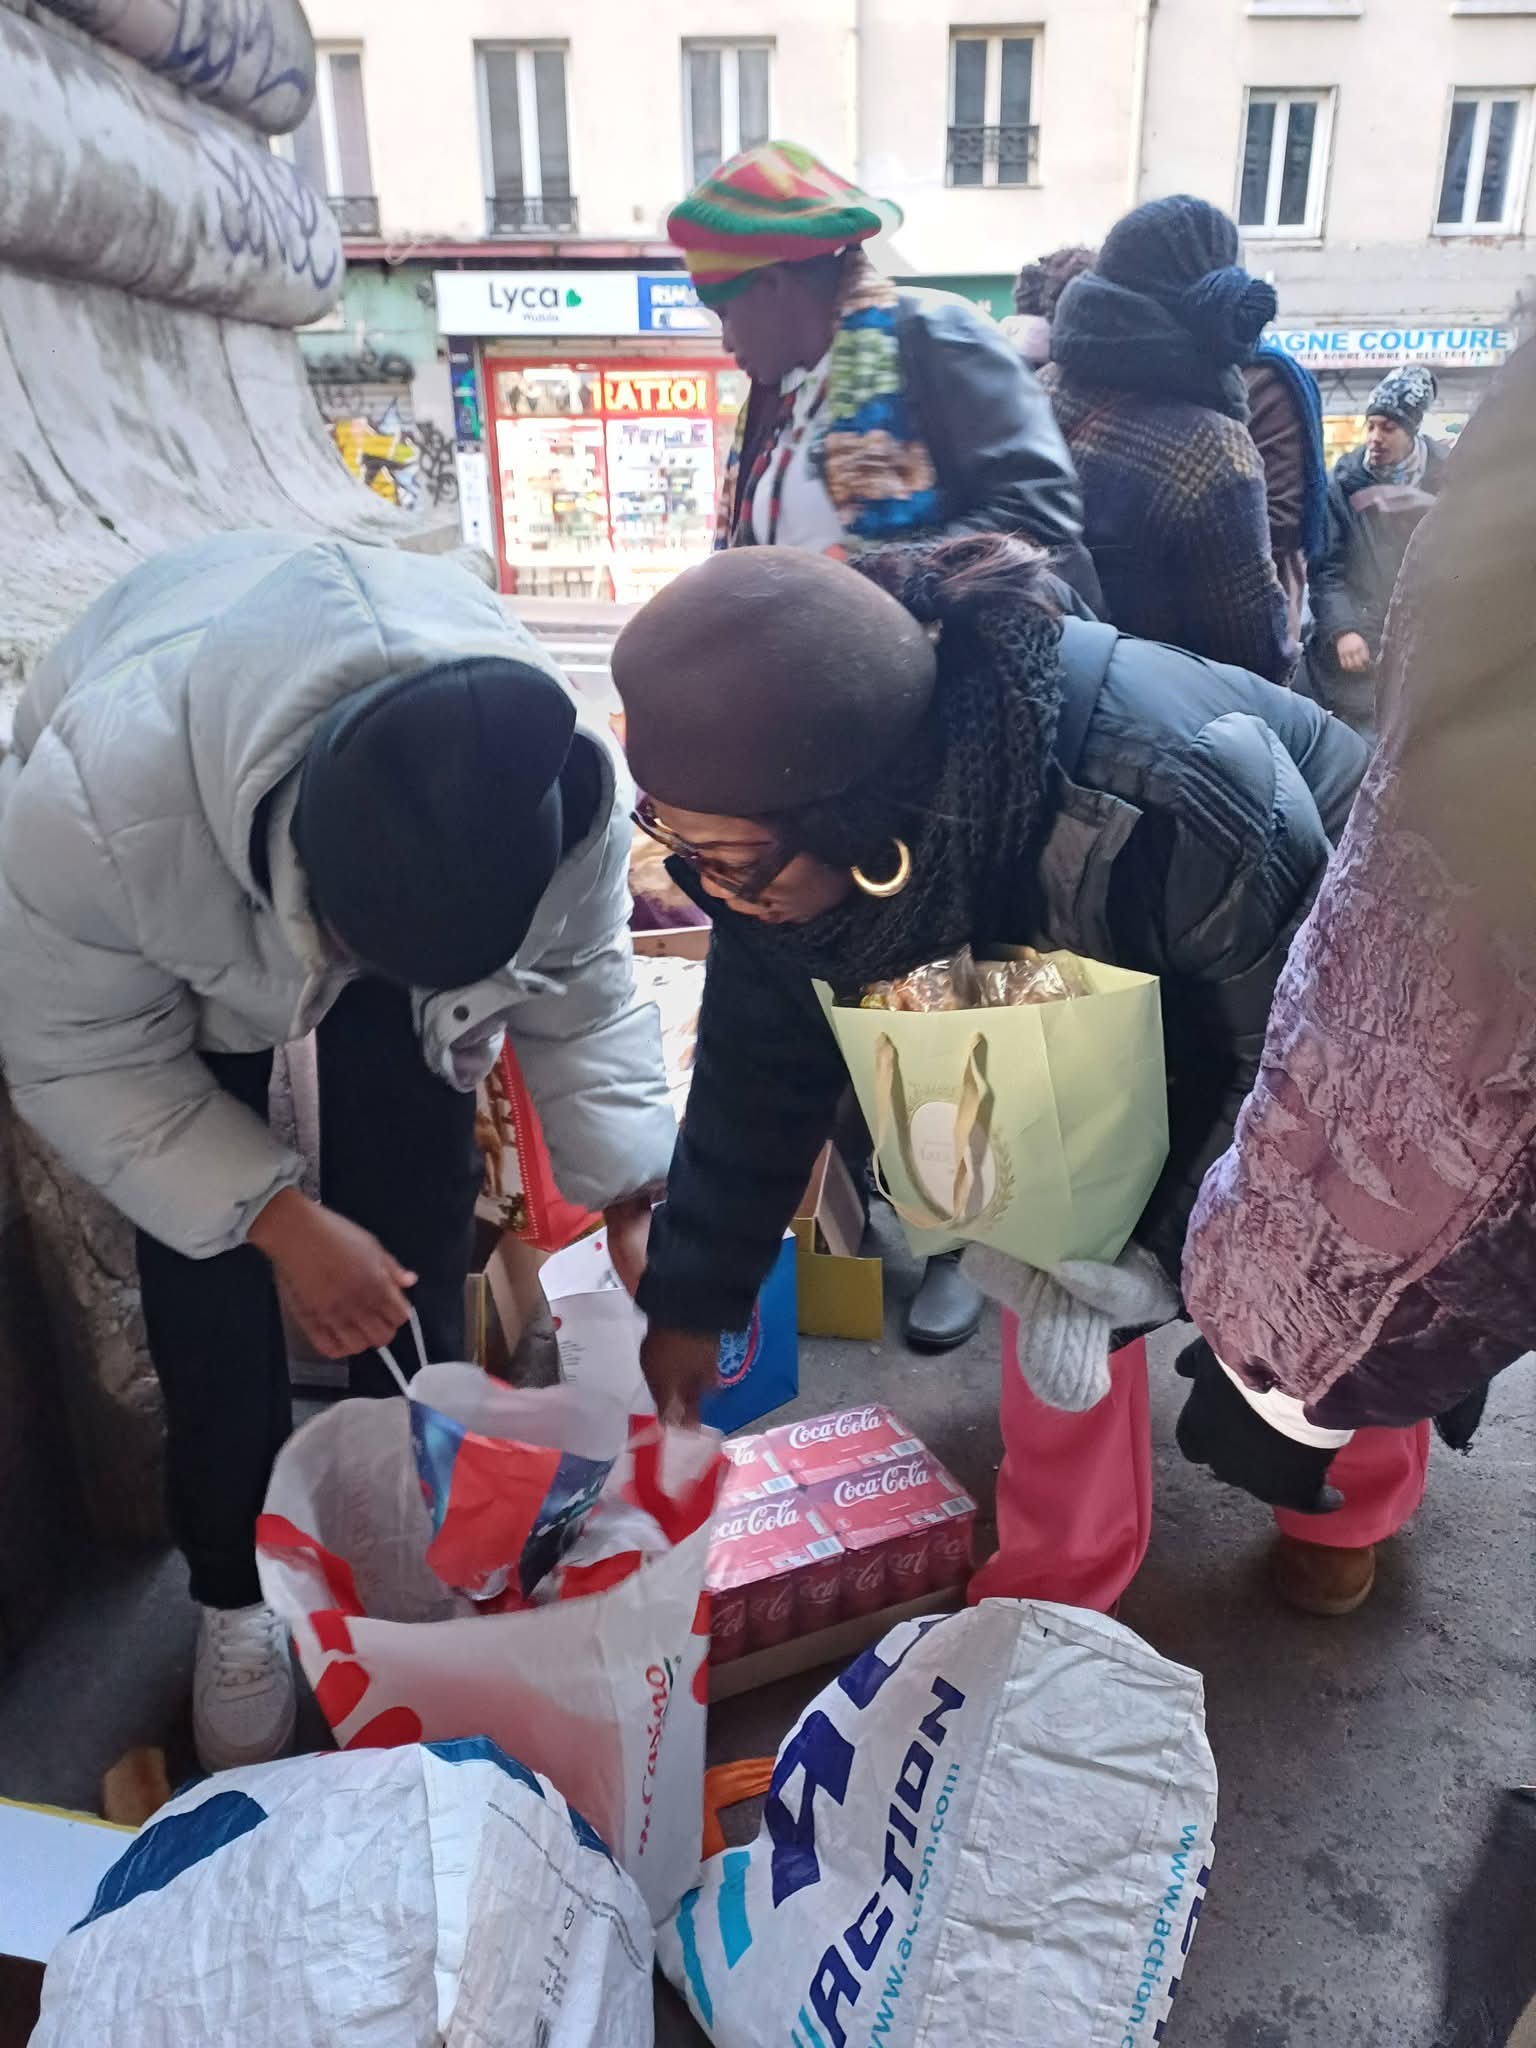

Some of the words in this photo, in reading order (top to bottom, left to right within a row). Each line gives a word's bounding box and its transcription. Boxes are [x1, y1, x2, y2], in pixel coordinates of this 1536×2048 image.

[489, 281, 559, 313] Lyca
[1359, 329, 1509, 351] COUTURE
[788, 1407, 882, 1449] Coca-Cola
[833, 1460, 929, 1507] Coca-Cola
[808, 1675, 967, 2048] ACTION
